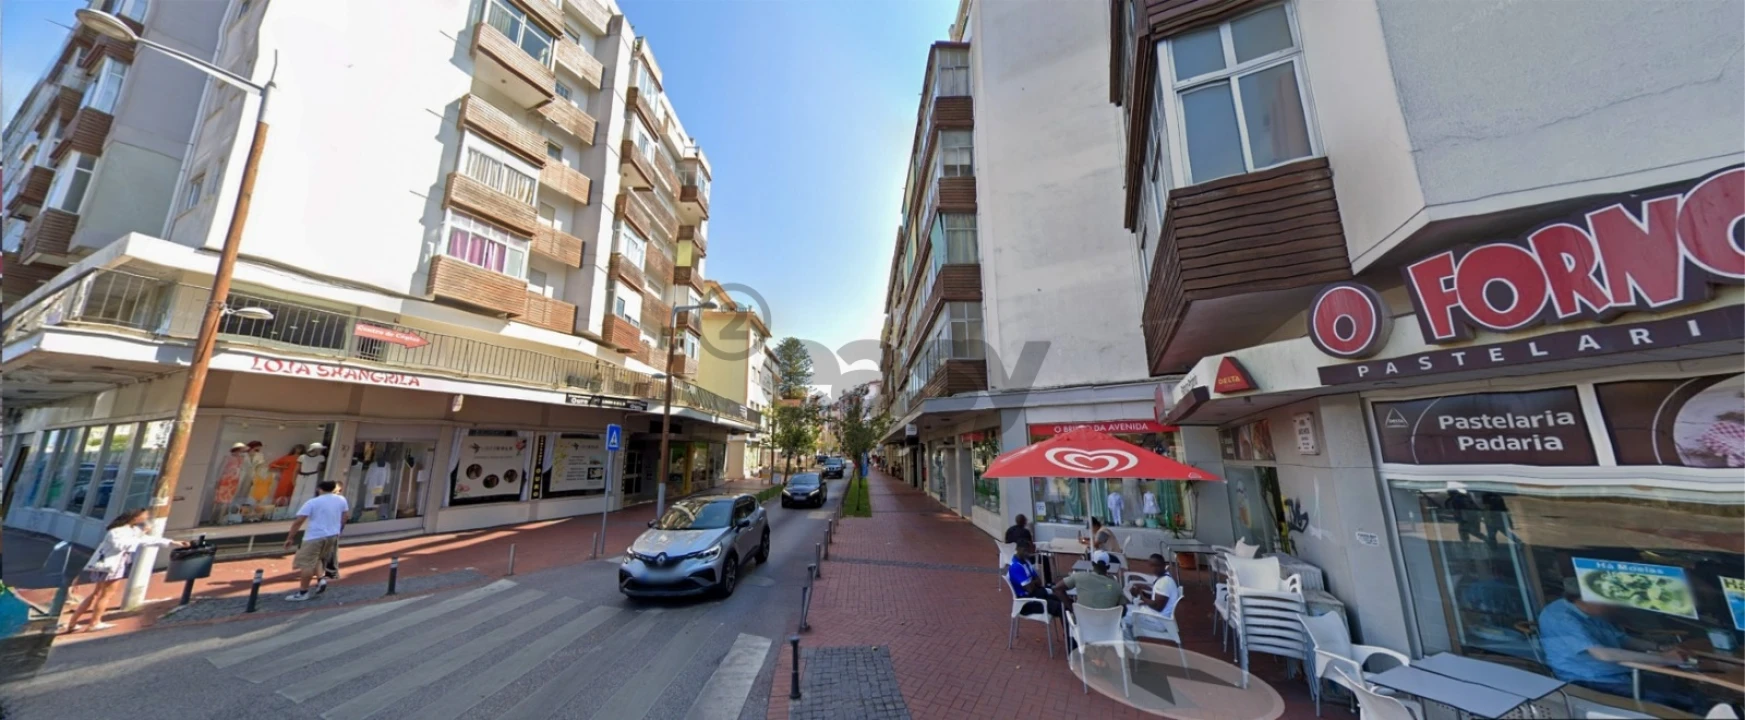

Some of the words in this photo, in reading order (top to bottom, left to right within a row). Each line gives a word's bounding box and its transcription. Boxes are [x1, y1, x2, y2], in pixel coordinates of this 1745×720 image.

[1312, 285, 1376, 355] O
[1357, 319, 1701, 378] PASTELARI
[251, 357, 310, 376] LOJA
[316, 365, 420, 387] SHANGRILA
[1217, 375, 1241, 386] DELTA
[1053, 425, 1062, 434] O
[1094, 424, 1107, 432] DA
[1108, 422, 1149, 431] AVENIDA
[1437, 410, 1576, 431] Pastelaria
[1458, 434, 1564, 452] Padaria
